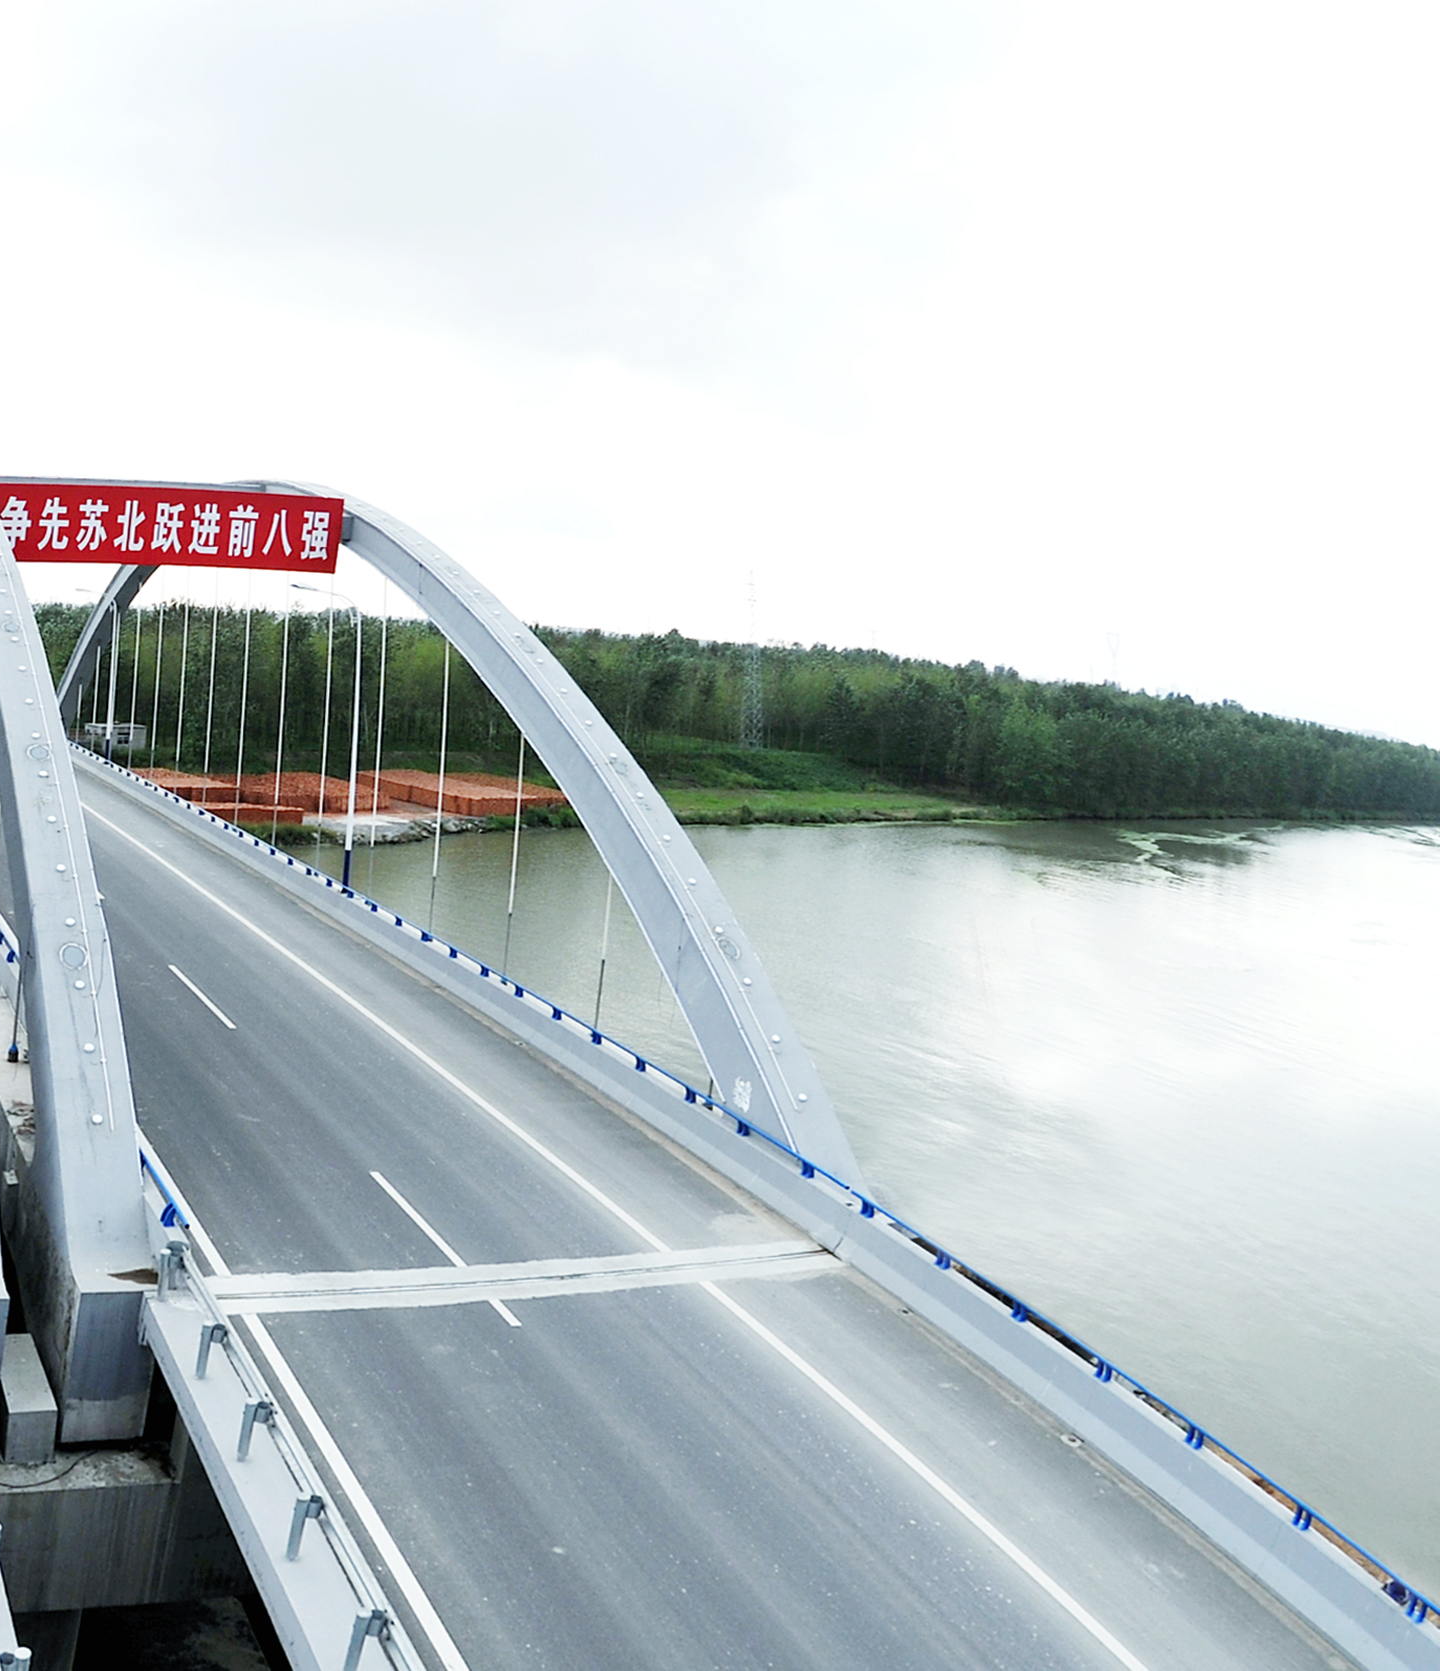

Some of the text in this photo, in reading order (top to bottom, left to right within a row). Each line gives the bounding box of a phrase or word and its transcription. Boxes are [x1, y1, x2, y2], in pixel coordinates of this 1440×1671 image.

[0, 495, 330, 561] 争先苏北跃进前八强
